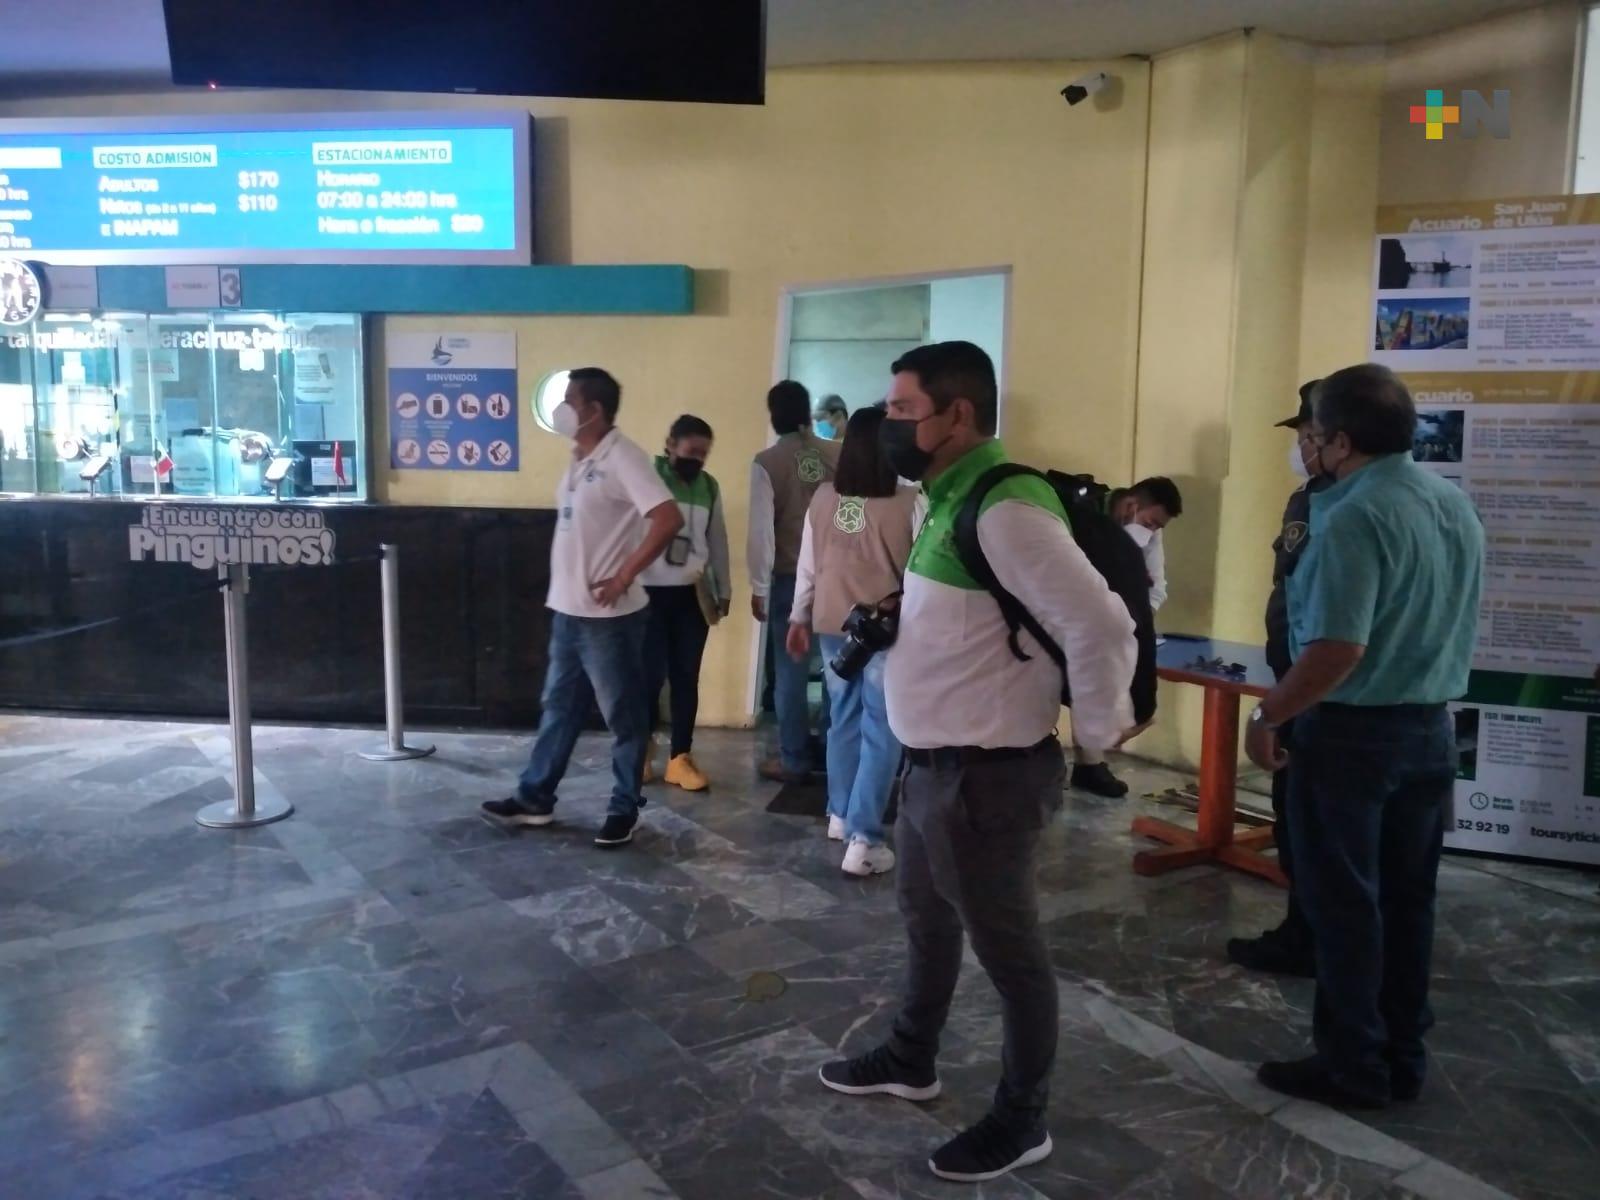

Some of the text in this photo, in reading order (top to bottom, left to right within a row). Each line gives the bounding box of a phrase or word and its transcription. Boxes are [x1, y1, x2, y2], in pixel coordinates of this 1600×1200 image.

[99, 152, 212, 165] COSTO ADMISION
[317, 148, 447, 161] ESTACIONAMIENTO
[238, 171, 279, 189] $170
[238, 194, 278, 212] $110
[1408, 216, 1482, 232] Acuario
[222, 272, 240, 305] 3
[426, 373, 478, 382] BIENVENIDOS
[1414, 388, 1474, 403] cuario
[277, 510, 322, 528] con
[129, 525, 333, 569] Pingüinos!
[1457, 819, 1510, 835] 32 92 19
